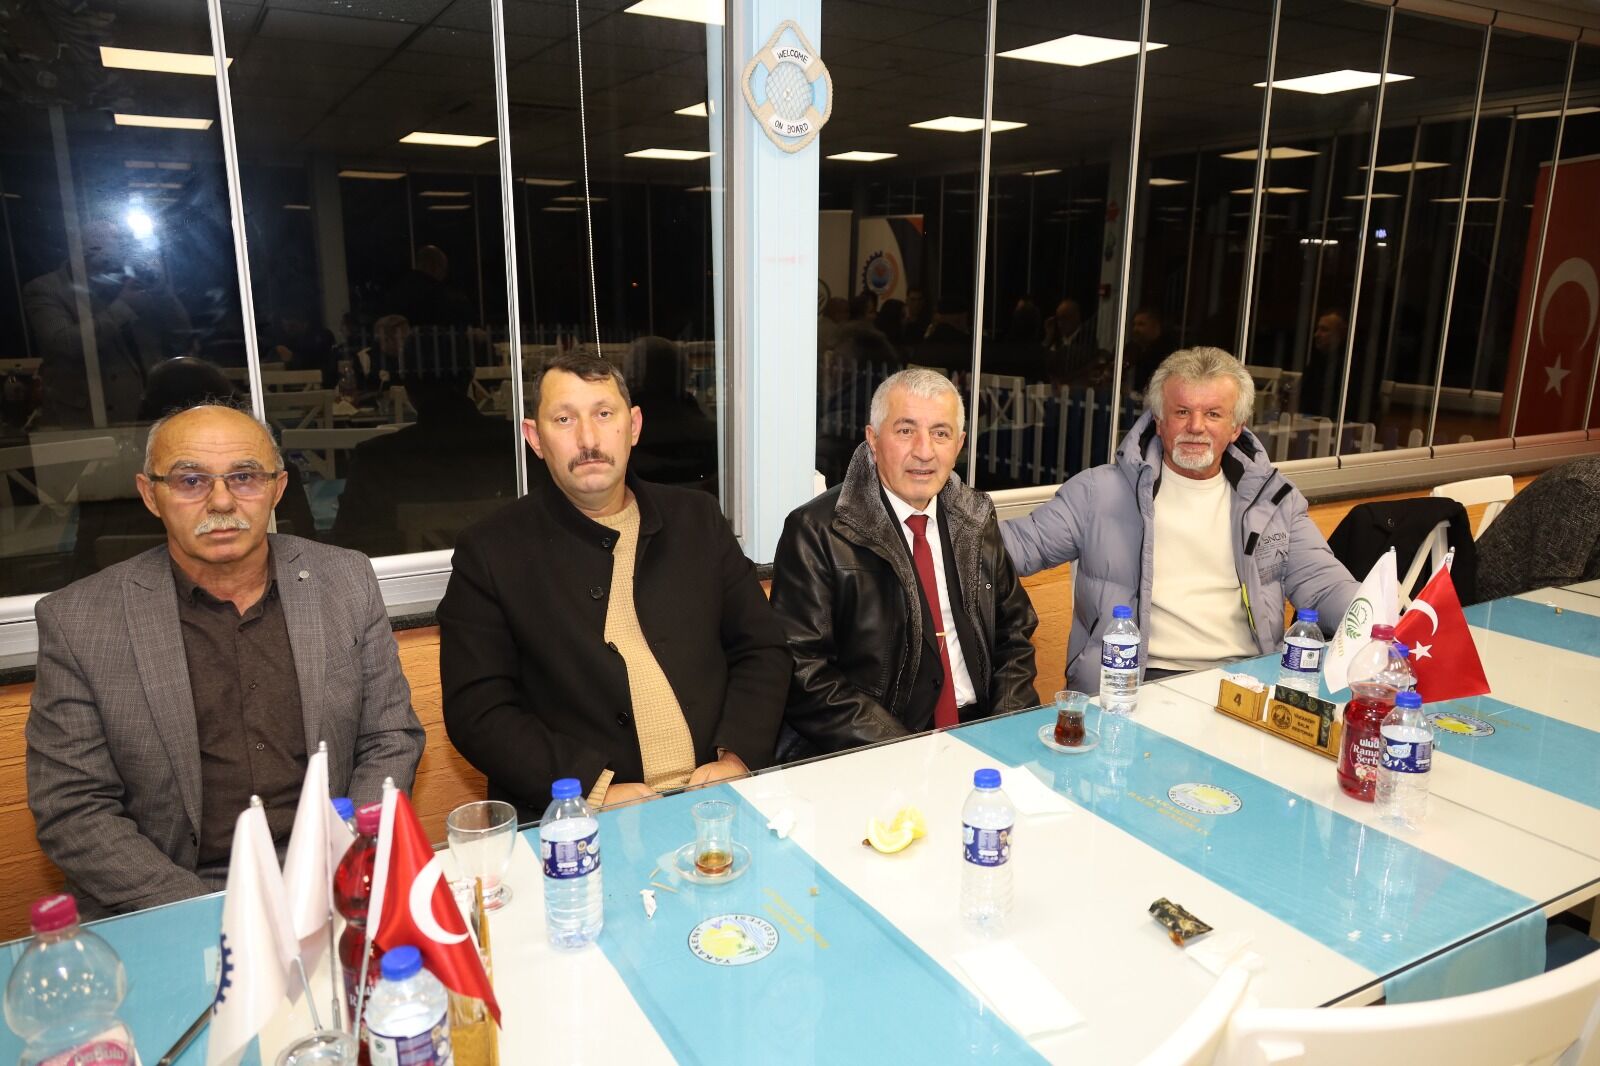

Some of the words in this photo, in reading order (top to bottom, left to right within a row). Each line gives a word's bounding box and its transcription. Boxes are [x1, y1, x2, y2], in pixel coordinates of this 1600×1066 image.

[777, 49, 808, 63] WELCOME
[775, 120, 783, 130] ON
[787, 122, 809, 134] BOARD
[1233, 693, 1242, 706] 4
[1360, 739, 1379, 748] ulud
[1353, 744, 1380, 757] Rama
[1356, 753, 1377, 764] Şerb
